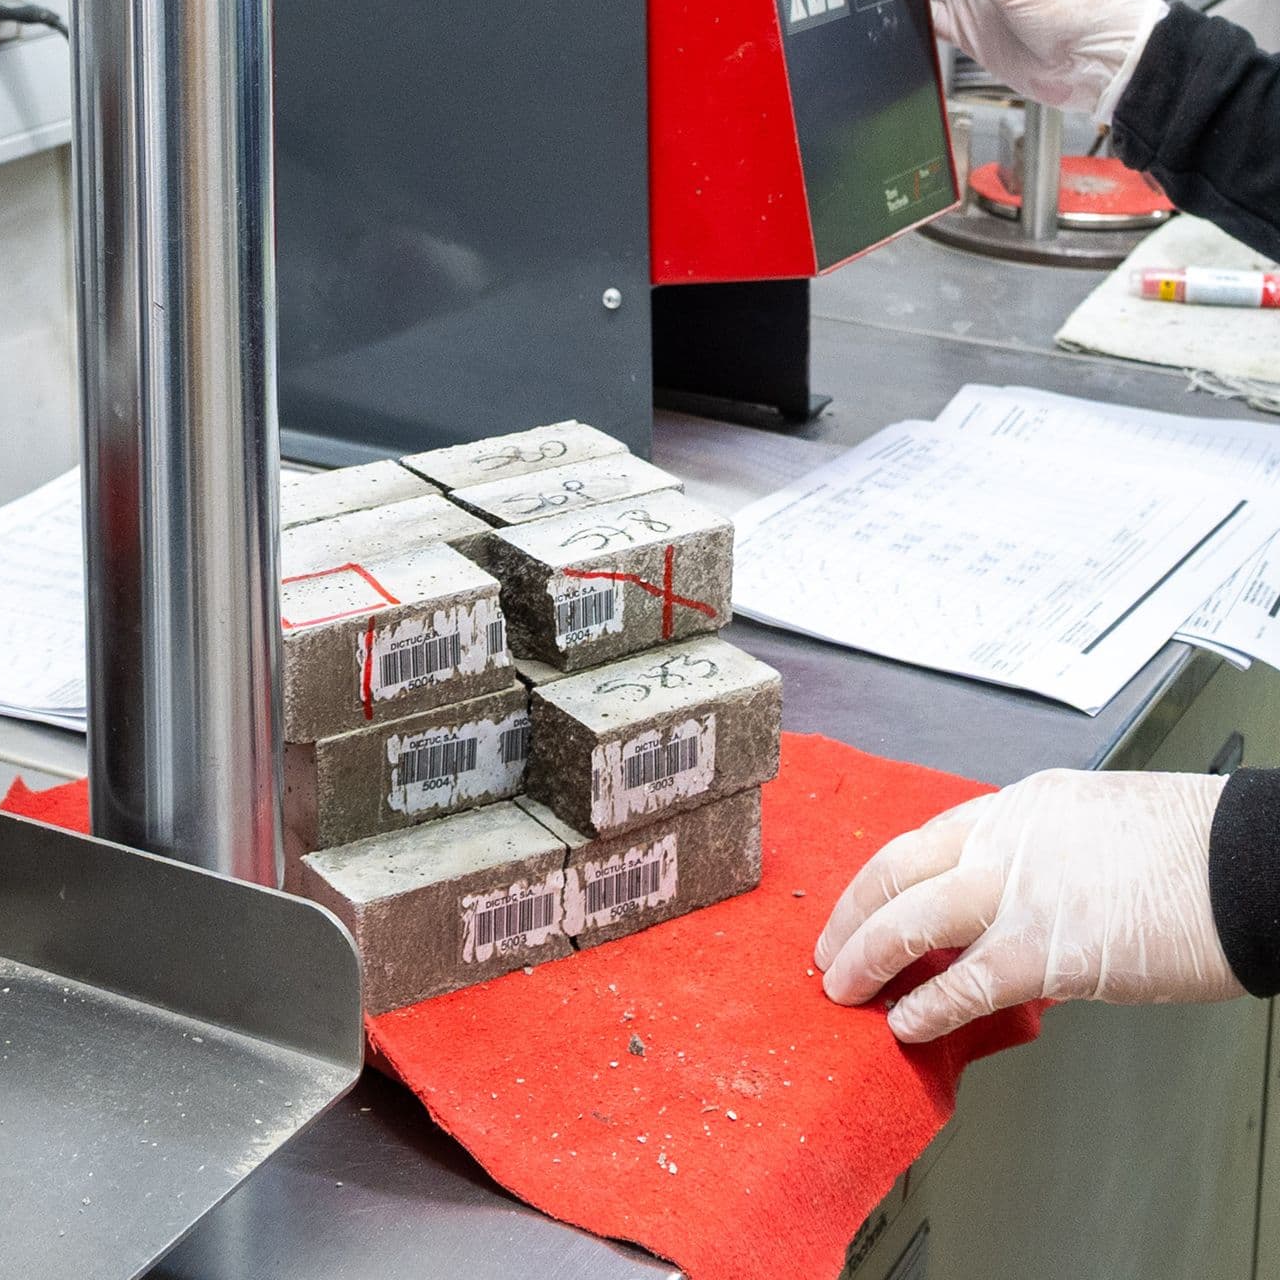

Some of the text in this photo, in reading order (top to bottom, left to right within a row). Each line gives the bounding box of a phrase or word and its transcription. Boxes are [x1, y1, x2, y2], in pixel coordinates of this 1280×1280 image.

[390, 634, 424, 651] DICTUC
[408, 674, 434, 691] 5004
[409, 734, 441, 750] DICTUC
[634, 739, 660, 754] DICTU
[421, 776, 451, 792] 5004
[595, 862, 627, 878] DICTUC
[610, 900, 637, 918] 5003
[501, 933, 528, 951] 5003
